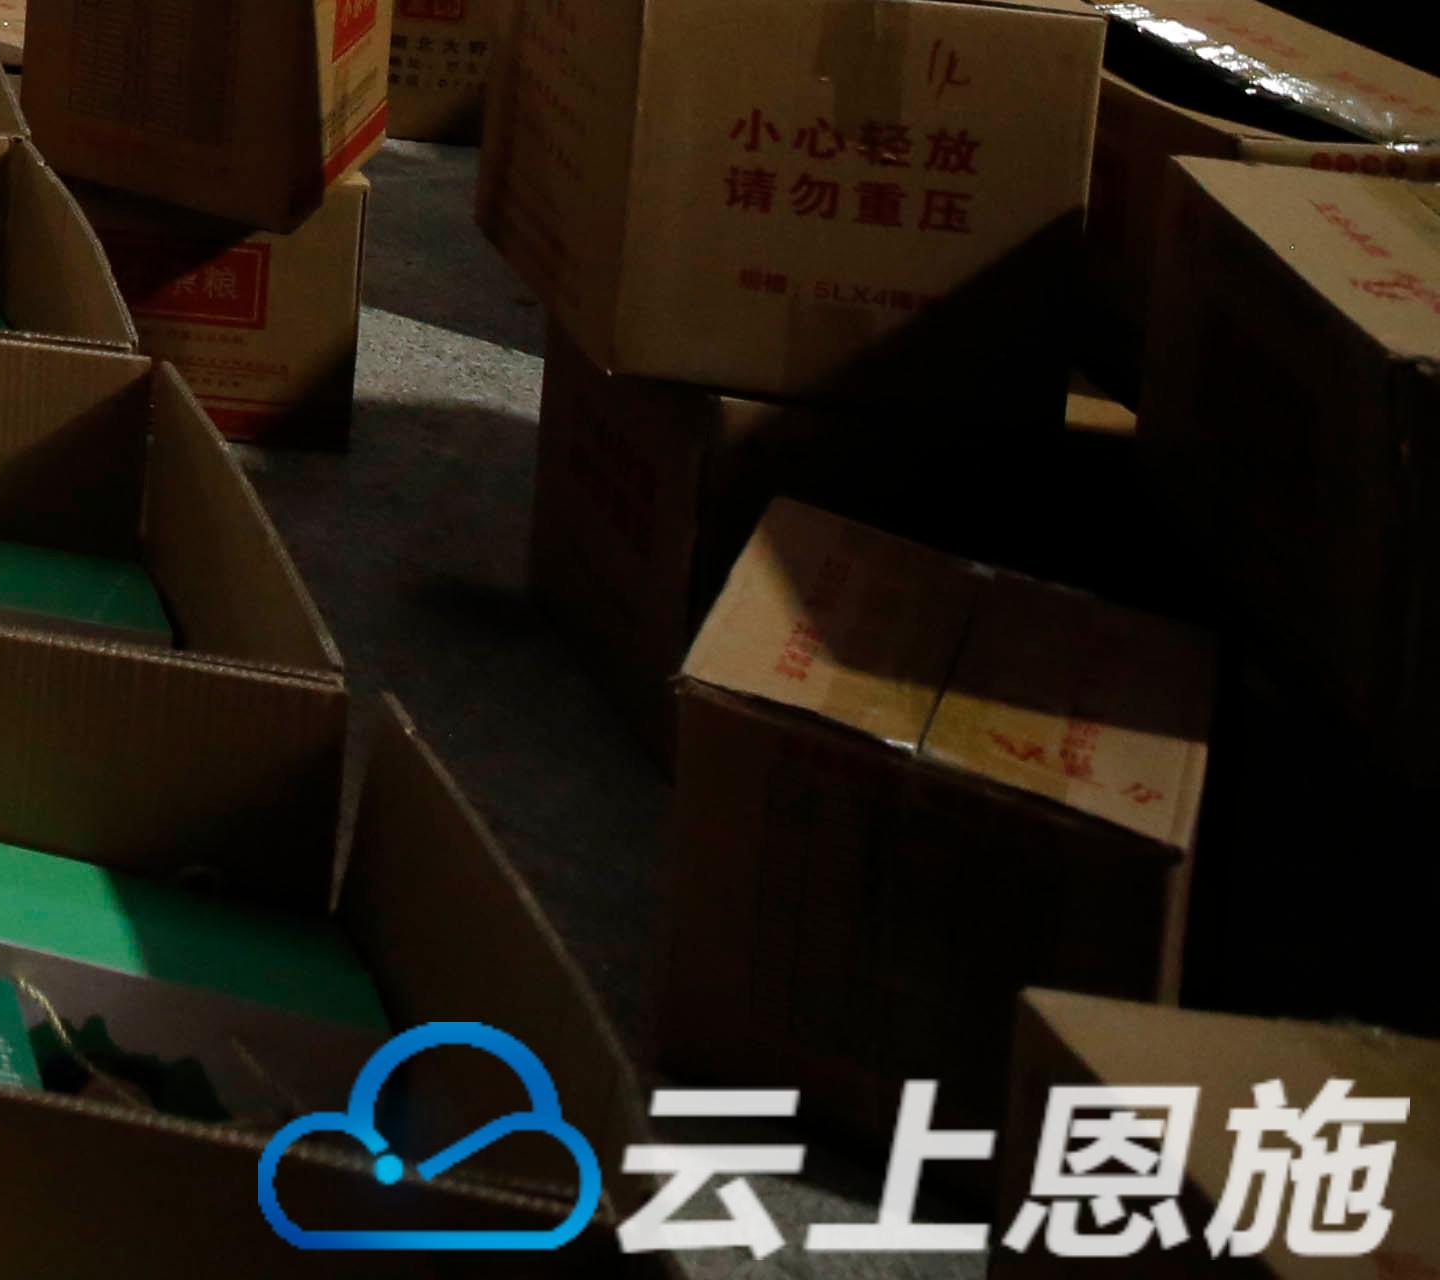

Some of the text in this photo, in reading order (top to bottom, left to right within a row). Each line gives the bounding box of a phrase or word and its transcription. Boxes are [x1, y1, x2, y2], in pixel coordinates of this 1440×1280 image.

[730, 107, 981, 175] 小心轻放
[725, 166, 973, 235] 请勿重压
